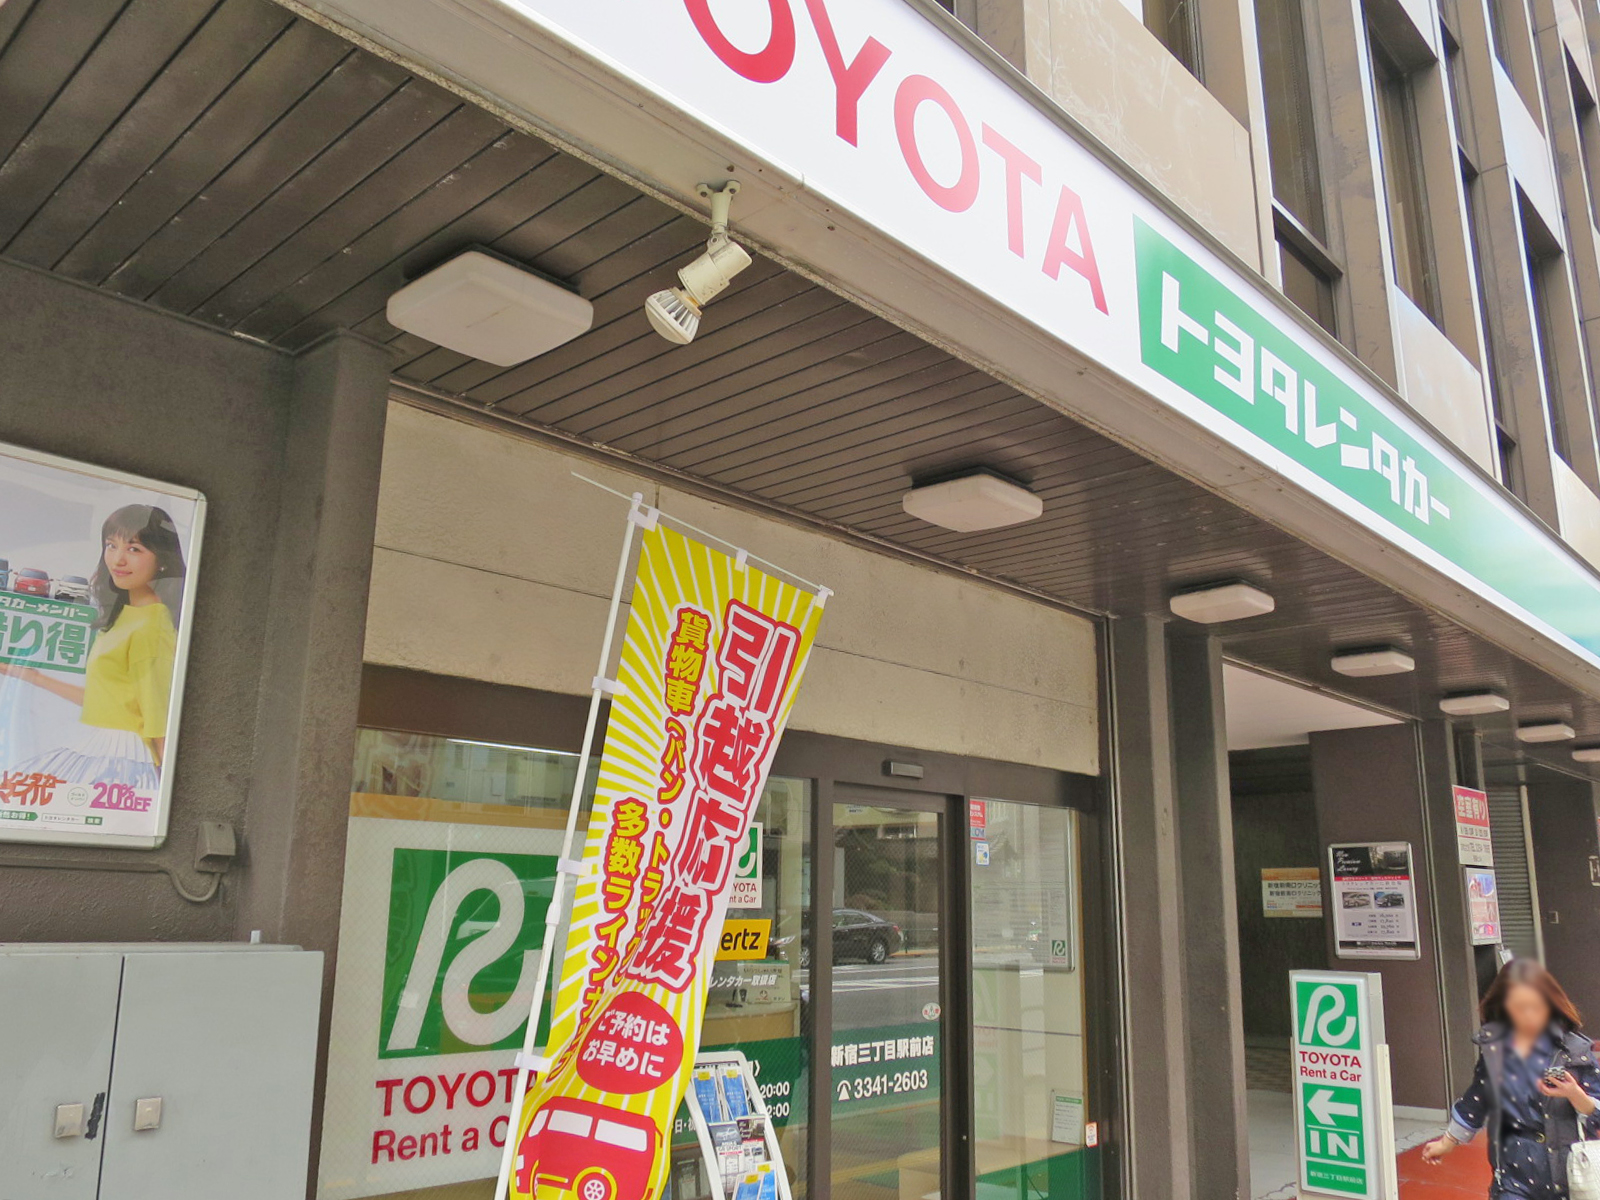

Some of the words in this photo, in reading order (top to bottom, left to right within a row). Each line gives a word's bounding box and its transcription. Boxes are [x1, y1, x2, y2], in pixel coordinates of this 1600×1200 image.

[1160, 270, 1451, 525] トヨタレンタカー
[632, 604, 796, 986] 引越応援
[733, 883, 757, 892] YOTA
[743, 895, 756, 903] Car
[721, 928, 761, 951] ertz
[582, 1039, 664, 1077] お早めに
[831, 1036, 934, 1067] 新宿三丁目駅前店
[1299, 1051, 1362, 1068] TOYOTA
[854, 1069, 928, 1099] 3341-2603
[1300, 1066, 1327, 1079] Rent
[1330, 1072, 1337, 1080] a
[1339, 1069, 1362, 1082] Car
[766, 1102, 790, 1118] 2:00
[371, 1125, 452, 1164] Rent
[461, 1127, 479, 1152] a
[1310, 1130, 1359, 1159] IN
